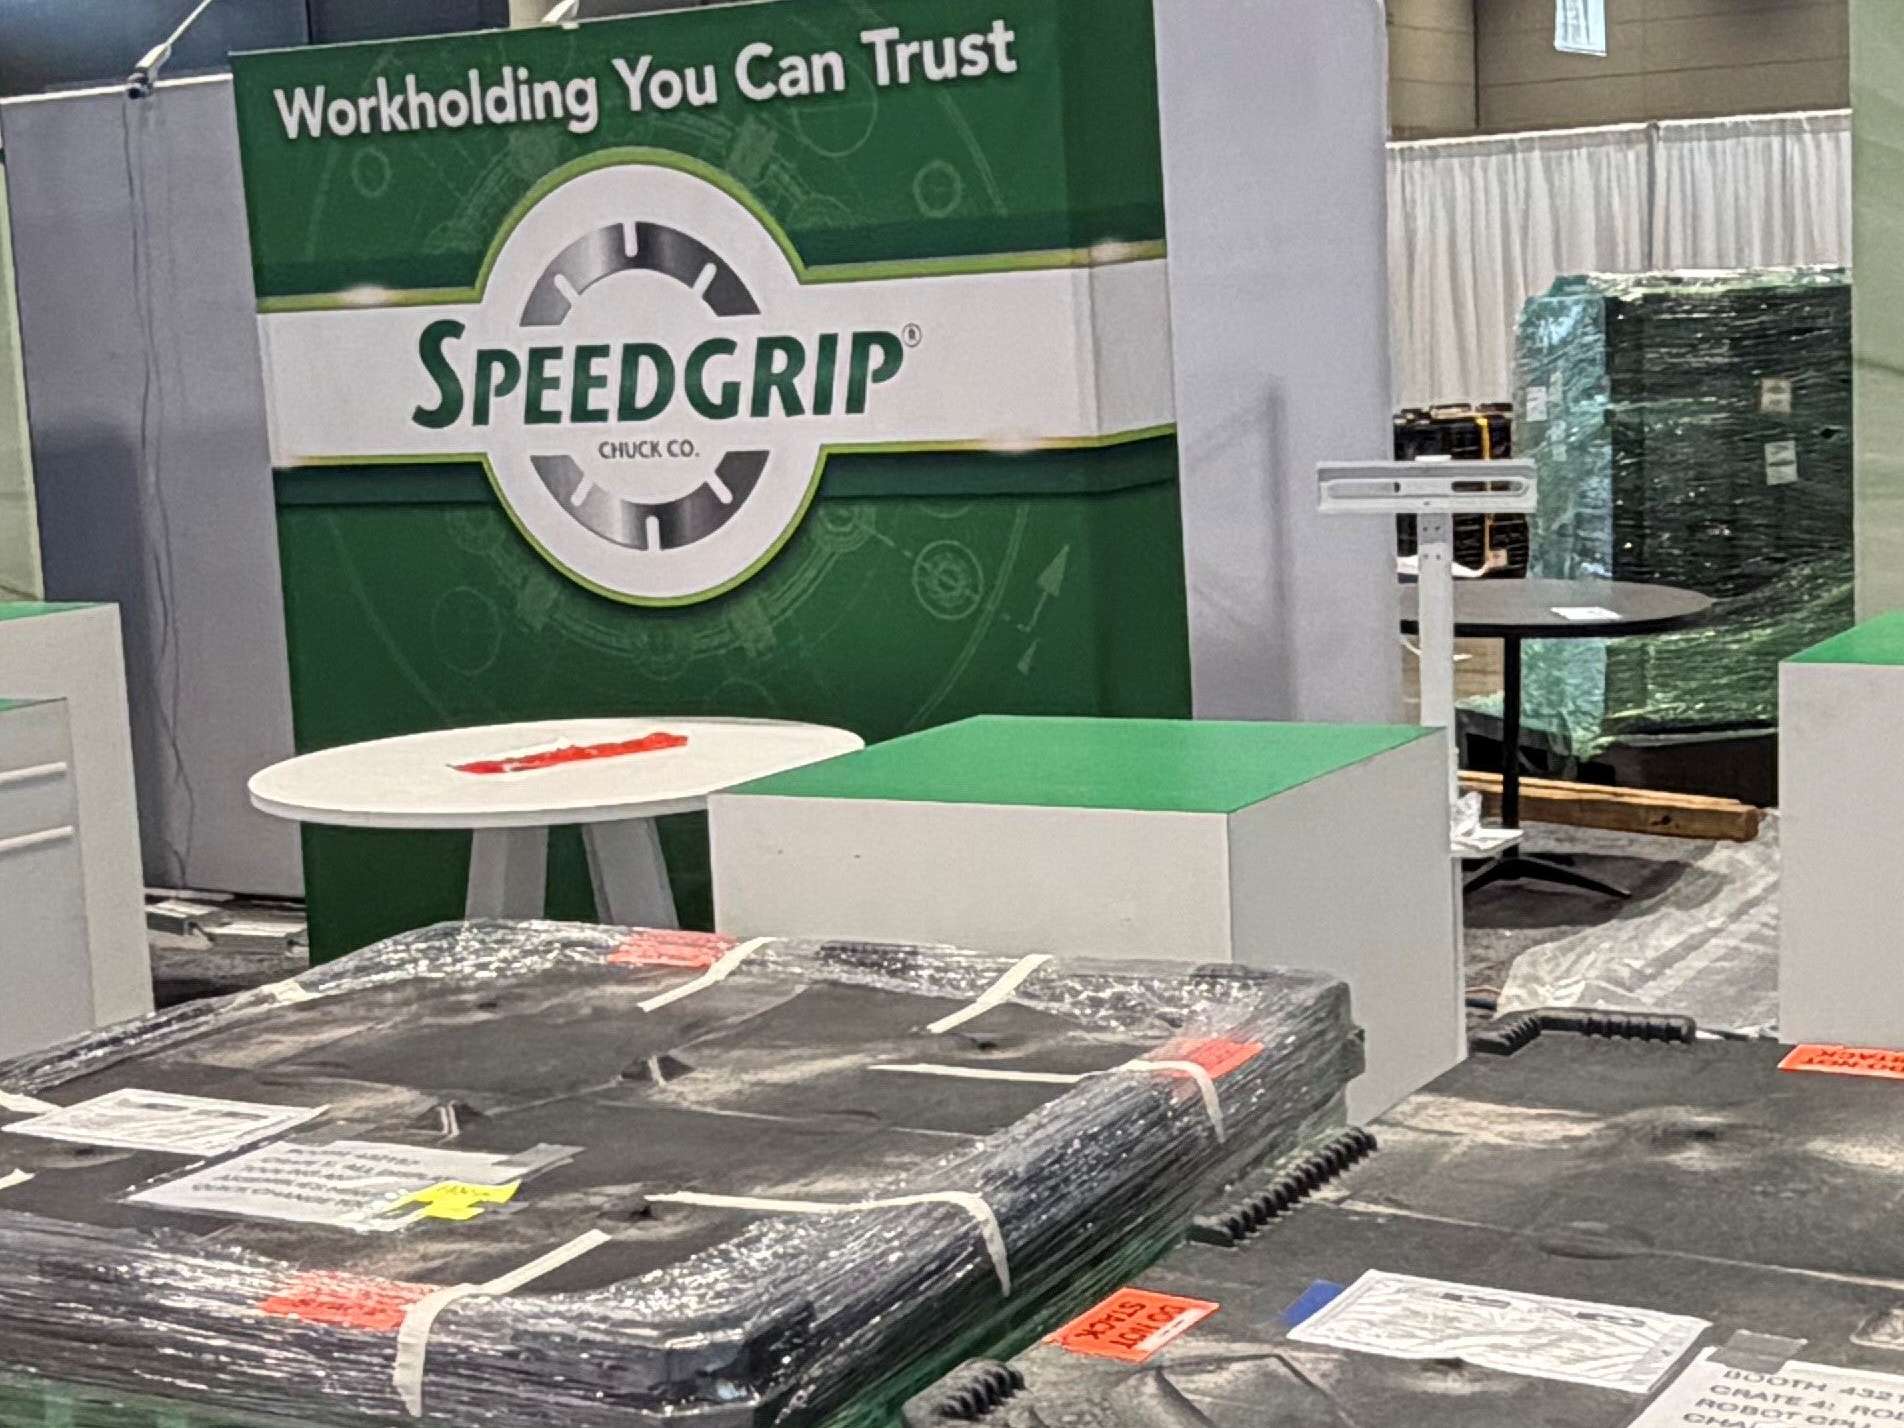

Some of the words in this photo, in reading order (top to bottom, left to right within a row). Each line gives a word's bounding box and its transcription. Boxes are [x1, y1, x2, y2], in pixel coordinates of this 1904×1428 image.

[274, 64, 602, 142] Workholding
[612, 55, 720, 114] You
[733, 40, 848, 102] Can
[860, 18, 1018, 87] Trust
[598, 440, 662, 461] CHUCK
[666, 438, 701, 458] CO.
[1074, 1301, 1146, 1339] STACK
[1147, 1304, 1186, 1322] DO
[1109, 1322, 1161, 1349] NOT
[1723, 1369, 1827, 1392] BOOTH
[1709, 1385, 1801, 1408] CRATE
[1694, 1398, 1800, 1422] ROBOT
